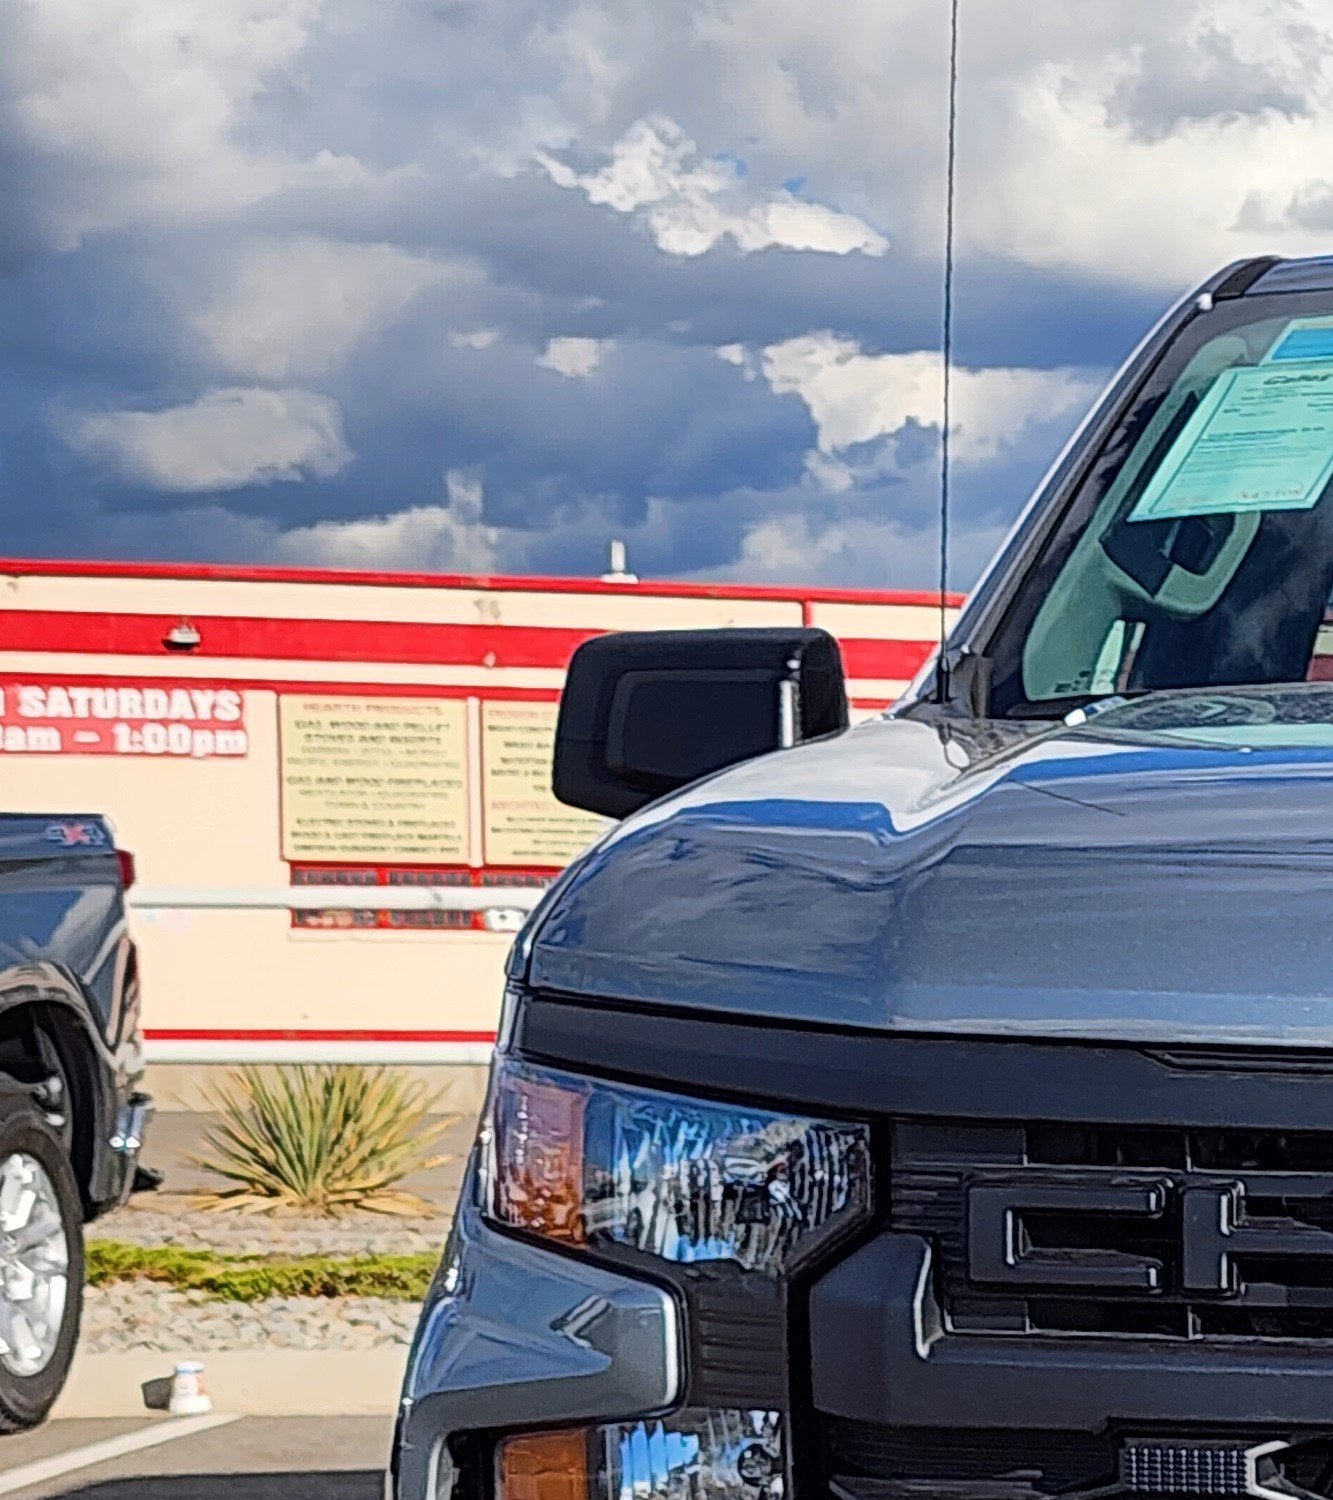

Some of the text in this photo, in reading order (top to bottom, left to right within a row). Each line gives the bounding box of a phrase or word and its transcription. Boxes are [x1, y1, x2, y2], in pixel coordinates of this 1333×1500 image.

[17, 686, 242, 721] SATURDAYS
[0, 724, 62, 751] am
[112, 722, 248, 758] 1:00pm
